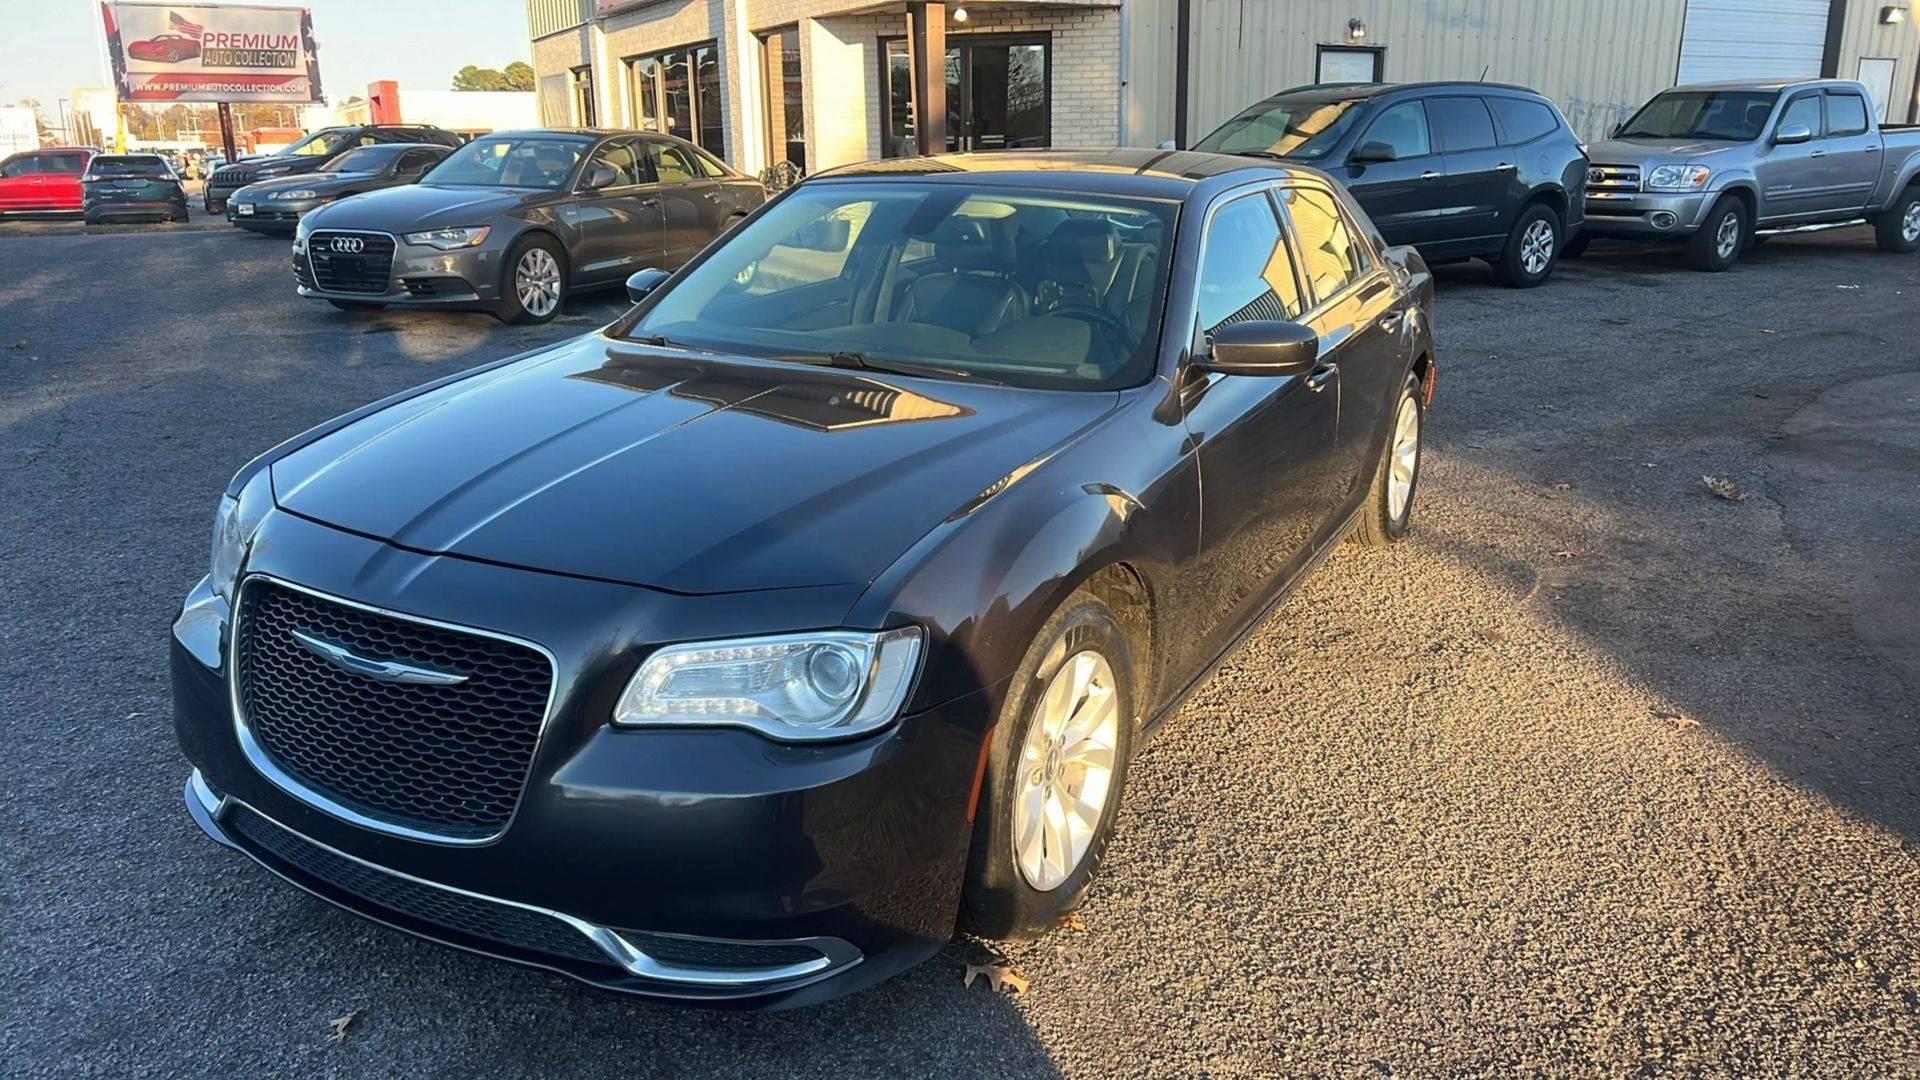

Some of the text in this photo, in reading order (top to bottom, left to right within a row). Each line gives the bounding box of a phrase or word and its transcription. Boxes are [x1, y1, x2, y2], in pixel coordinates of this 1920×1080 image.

[203, 32, 298, 49] PREMIUM
[204, 50, 295, 66] AUTO COLLECTION
[136, 82, 304, 92] WWW.PREMIUMAUTOCOLLECTION.COM
